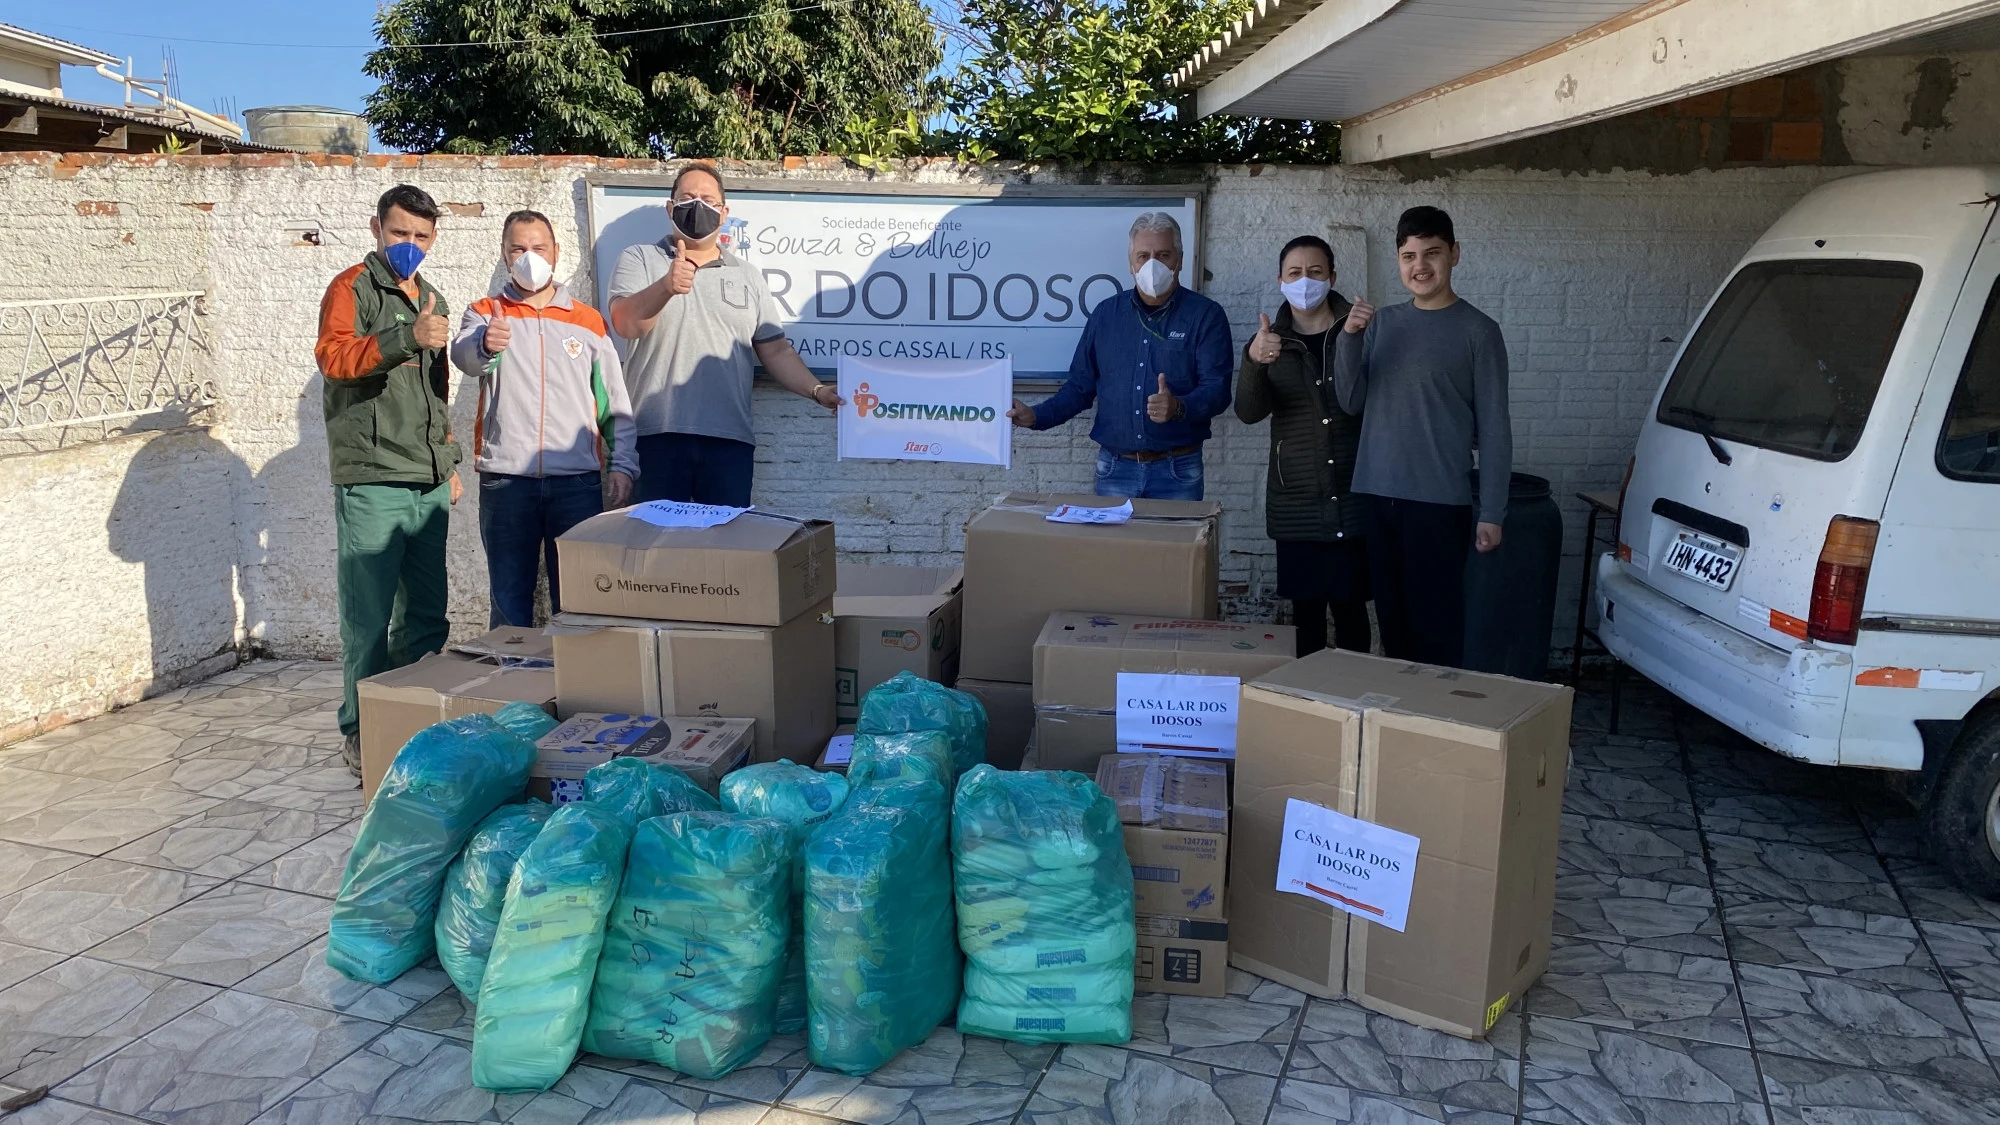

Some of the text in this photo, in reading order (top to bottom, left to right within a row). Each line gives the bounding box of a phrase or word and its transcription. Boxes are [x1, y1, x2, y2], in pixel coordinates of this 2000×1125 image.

[822, 217, 962, 231] Sociedade Beneficente
[756, 226, 992, 272] Souza & Balhejo
[815, 270, 908, 320] DO
[929, 272, 1124, 322] IDOSO
[878, 340, 960, 360] CASSAL
[980, 342, 1006, 359] RS
[904, 442, 929, 452] Stara
[617, 580, 740, 596] Minerva Fine Foods
[1127, 698, 1227, 712] CASA LAR DOS
[1151, 715, 1203, 727] IDOSOS
[1294, 829, 1400, 873] CASA LAR DOS
[1317, 853, 1371, 881] IDOSOS
